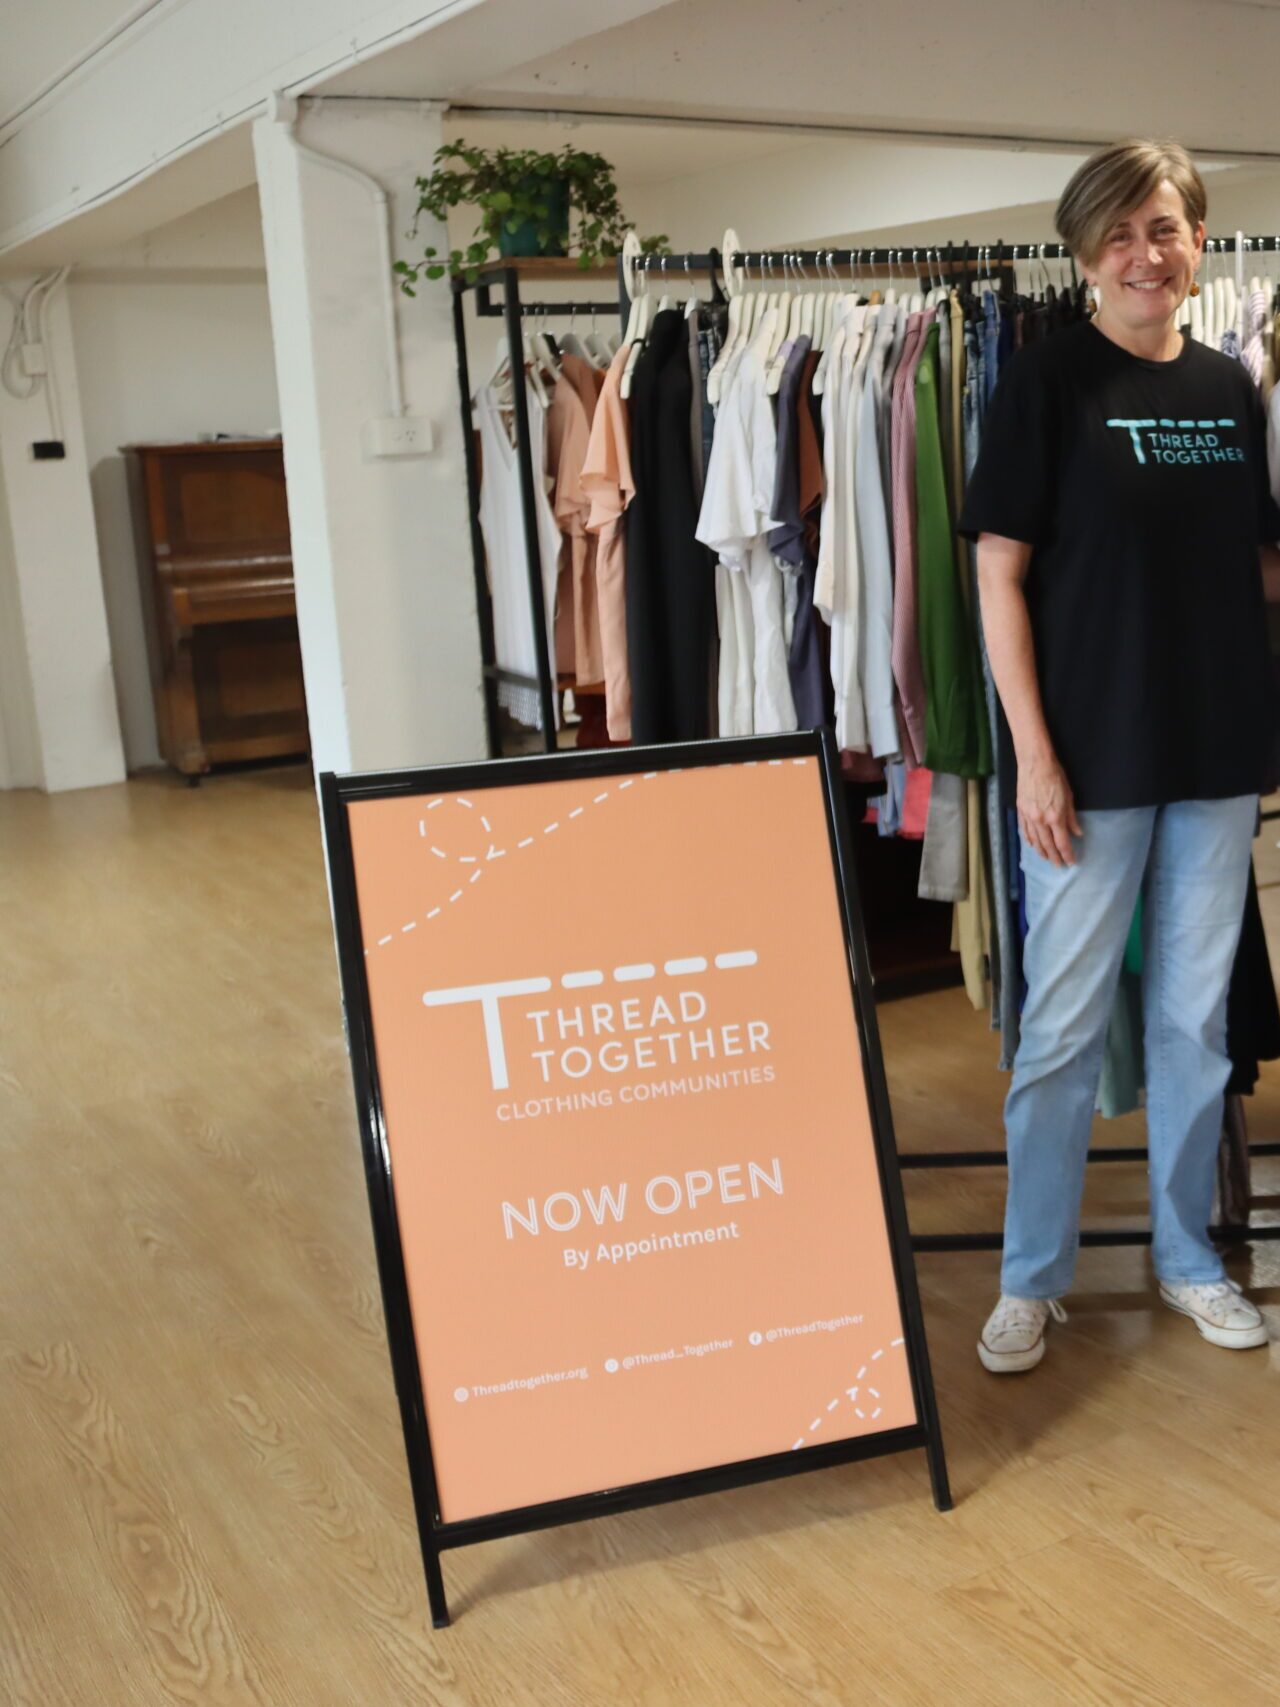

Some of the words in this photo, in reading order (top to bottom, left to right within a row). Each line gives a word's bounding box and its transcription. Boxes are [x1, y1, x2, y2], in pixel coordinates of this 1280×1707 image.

[1147, 433, 1218, 448] THREAD
[1152, 447, 1245, 464] TOGETHER
[526, 991, 706, 1042] THREAD
[531, 1020, 771, 1083] TOGETHER
[496, 1089, 613, 1121] CLOTHING
[619, 1065, 776, 1103] COMMUNITIES
[501, 1183, 628, 1240] NOW
[644, 1158, 784, 1215] OPEN
[562, 1248, 590, 1270] By
[596, 1221, 740, 1264] Appointment
[472, 1366, 588, 1397] Threadtogether.org
[766, 1314, 864, 1342] @ThreadTogether
